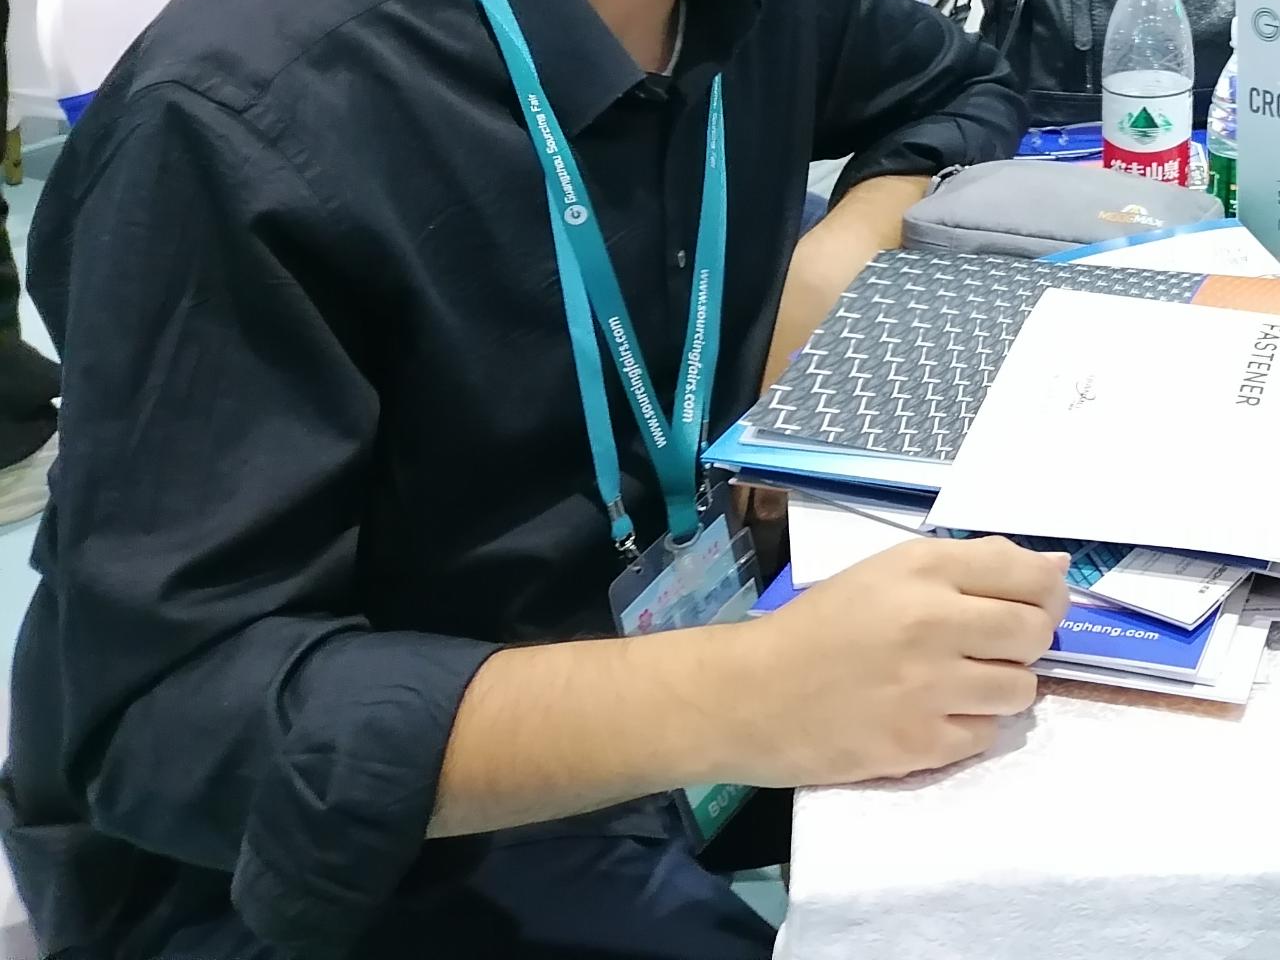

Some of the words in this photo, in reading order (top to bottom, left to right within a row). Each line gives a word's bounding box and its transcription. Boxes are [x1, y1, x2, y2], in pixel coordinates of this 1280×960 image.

[528, 94, 541, 112] Fair
[536, 113, 558, 154] Sourcing
[552, 154, 577, 204] Guangzhou
[682, 269, 711, 423] www.sourcingfairs.com
[608, 316, 667, 449] www.sourcingfairs.com
[1059, 618, 1160, 640] inghang.com
[708, 784, 739, 818] BUY
